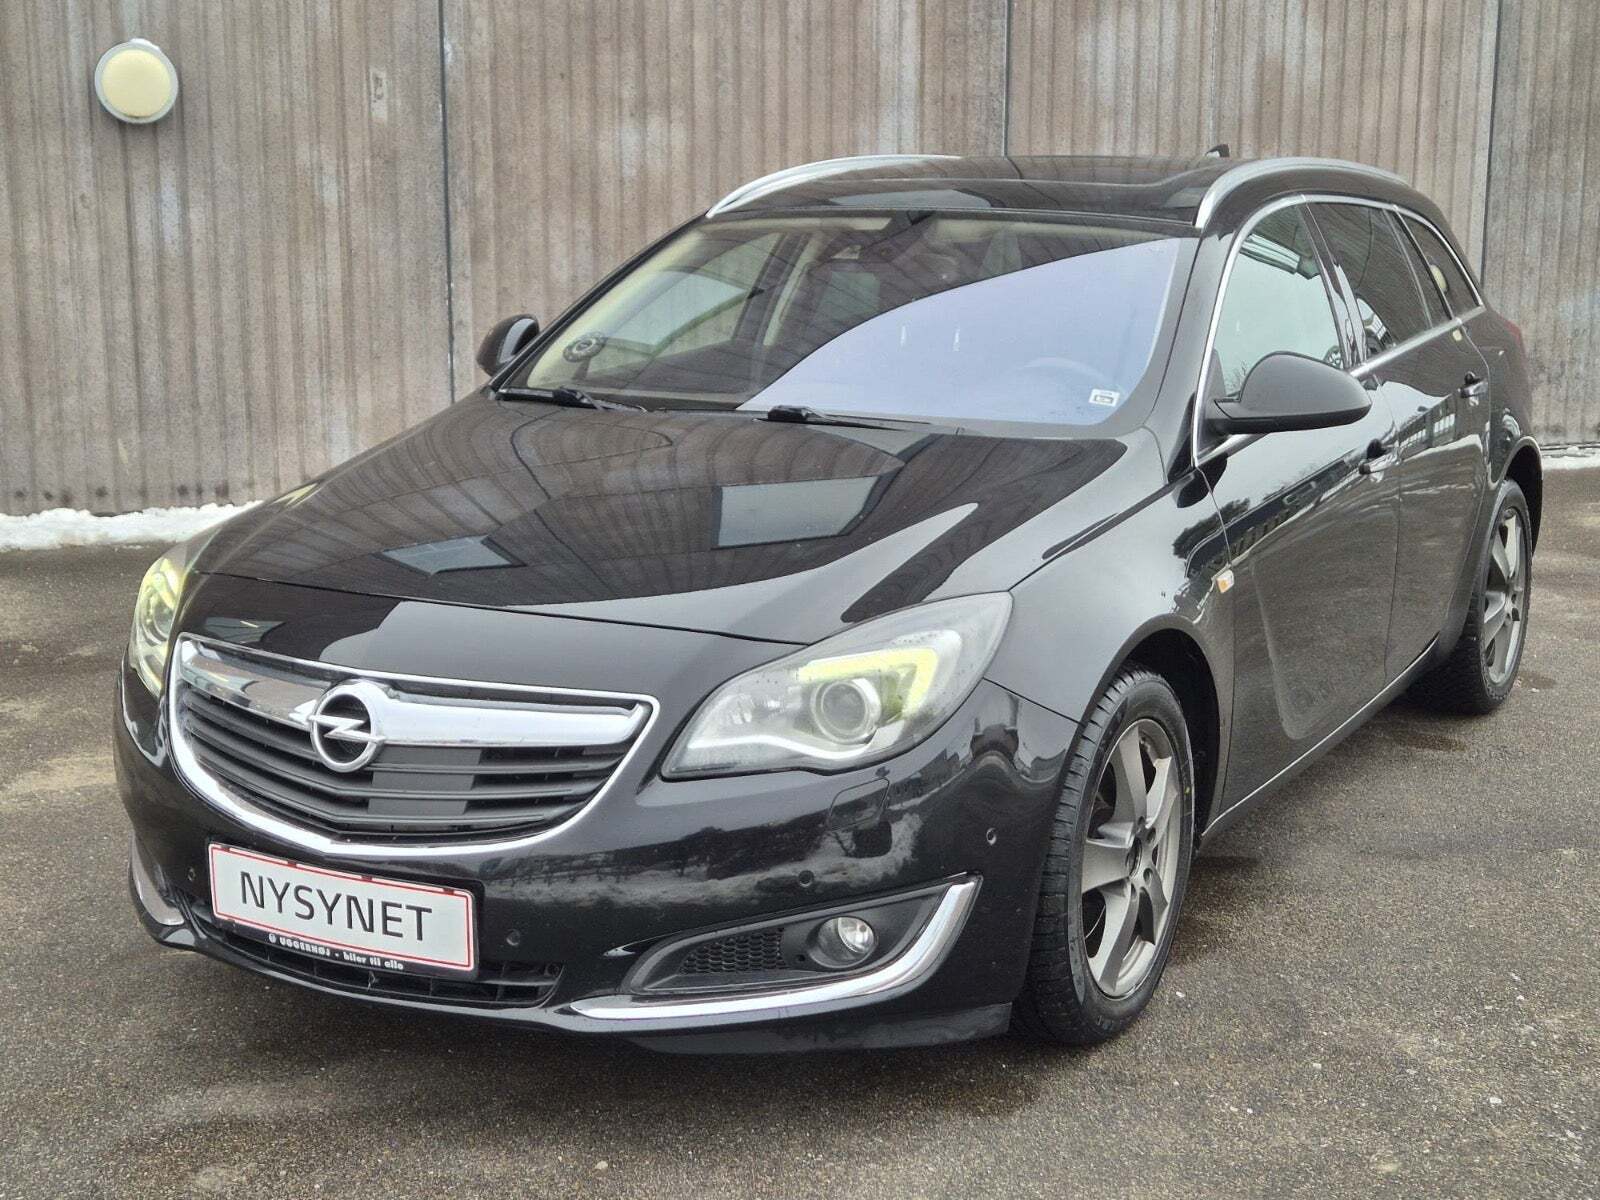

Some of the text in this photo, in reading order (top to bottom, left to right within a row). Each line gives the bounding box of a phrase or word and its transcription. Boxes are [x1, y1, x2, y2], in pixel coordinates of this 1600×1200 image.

[240, 871, 433, 941] NYSYNET
[343, 951, 367, 964] biler
[369, 957, 381, 967] til
